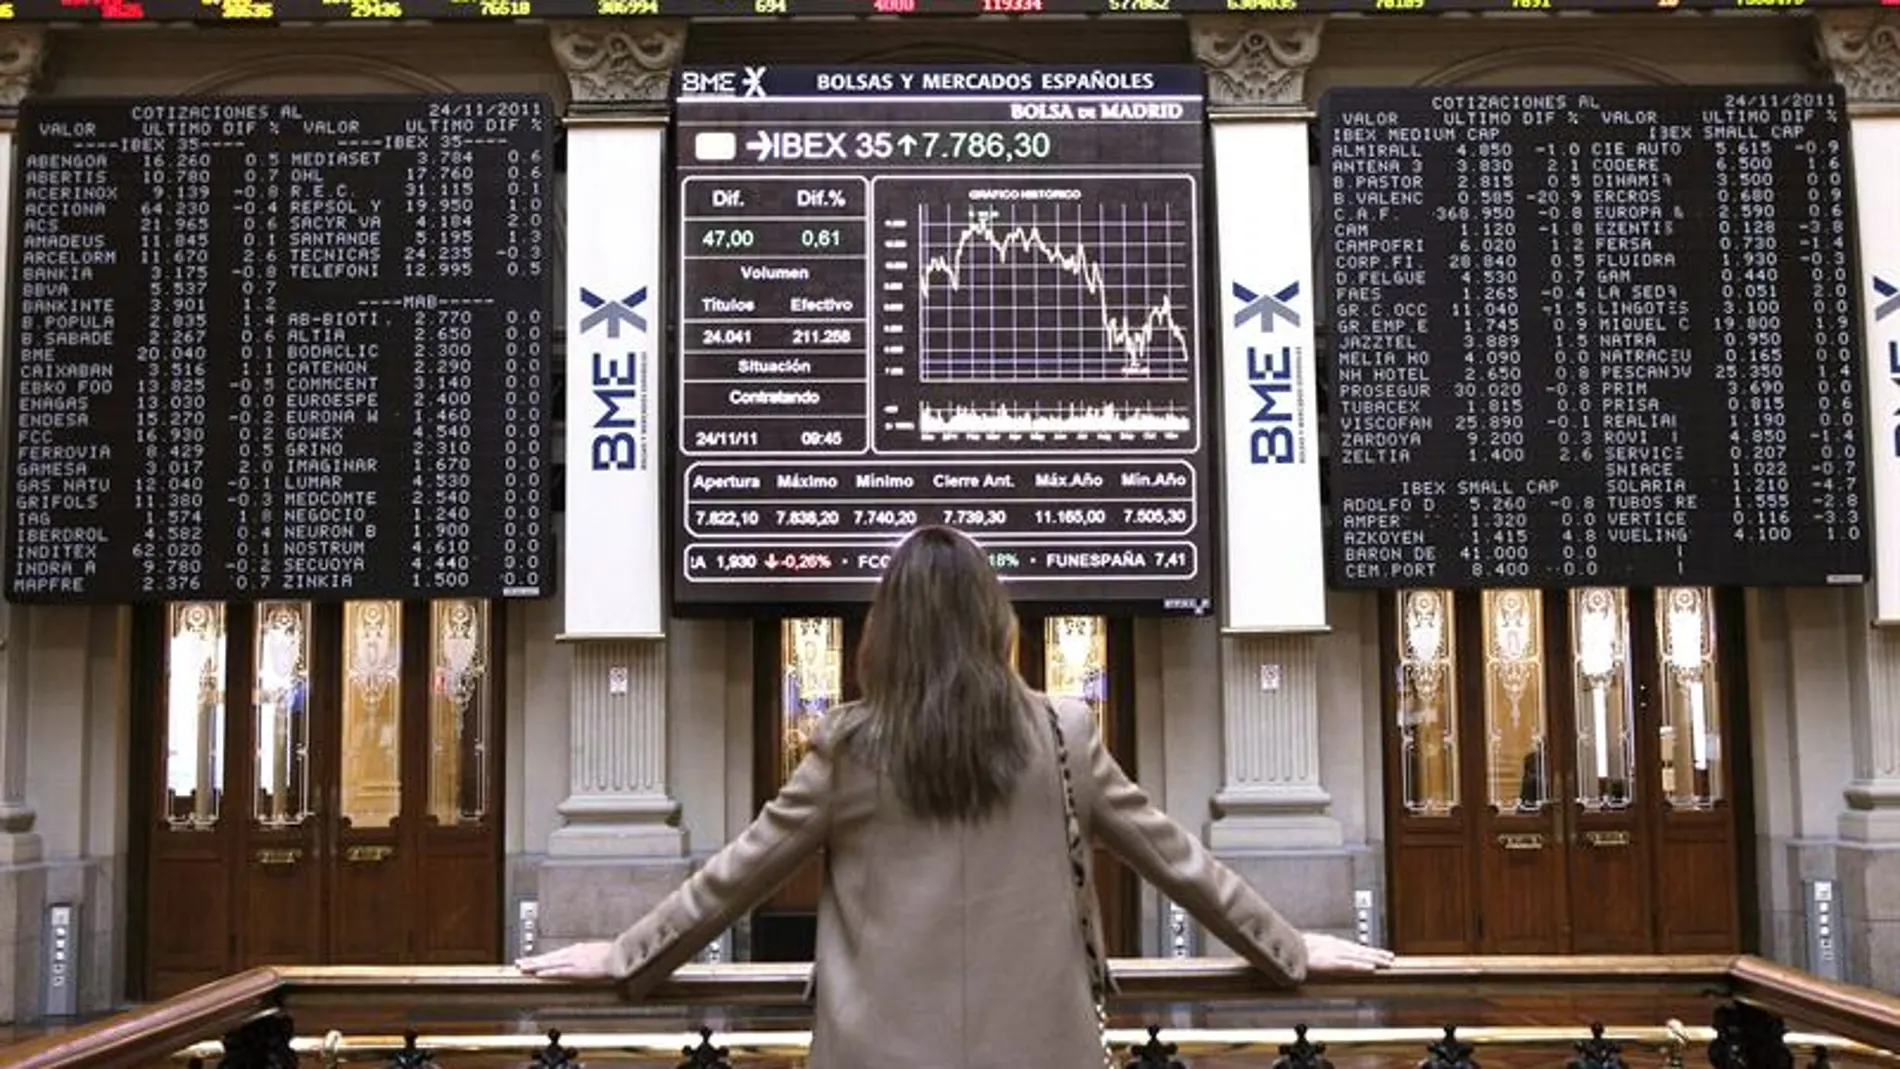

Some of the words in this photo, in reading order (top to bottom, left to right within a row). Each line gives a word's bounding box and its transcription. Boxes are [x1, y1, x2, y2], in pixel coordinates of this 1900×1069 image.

[682, 73, 736, 92] BME
[817, 74, 893, 90] BOLSAS
[901, 74, 914, 89] Y
[922, 73, 1032, 90] MERCADOS
[1042, 70, 1154, 89] ESPAÑOLES
[1432, 96, 1567, 110] COTIZACIONES
[1578, 95, 1599, 109] AL
[1725, 95, 1835, 107] 24/11/2011
[132, 106, 269, 120] COTIZACIONES
[281, 105, 302, 119] AL
[429, 103, 541, 117] 24/11/2011
[1011, 104, 1074, 119] BOLSA
[1100, 104, 1183, 119] MADRID
[1342, 113, 1399, 125] VALOR
[1443, 111, 1511, 125] ULTIMO
[1523, 111, 1555, 124] DIF
[1602, 111, 1657, 124] VALOR
[1702, 110, 1770, 123] ULTIMO
[1781, 110, 1814, 122] DIF
[39, 124, 97, 136] VALOR
[142, 124, 211, 136] ULTIMO
[223, 123, 255, 135] DIF
[304, 121, 360, 133] VALOR
[406, 119, 473, 132] ULTIMO
[486, 119, 518, 132] DIF
[531, 119, 542, 132] %
[1333, 129, 1376, 141] IBEX
[1388, 128, 1455, 140] MEDIUM
[1467, 128, 1500, 140] CAP
[773, 132, 846, 158] IBEX
[856, 132, 893, 158] 35
[922, 132, 1050, 162] 7.786,30
[1332, 145, 1422, 158] ALMIRALL
[25, 155, 108, 169] ABENGOA
[292, 153, 381, 166] MEDIASET
[1592, 159, 1659, 172] CODERE
[1332, 161, 1400, 173] ANTENA
[25, 171, 108, 184] ABERTIS
[292, 169, 324, 182] OHL
[407, 168, 473, 181] 17.760
[25, 187, 117, 200] ACERINOX
[712, 190, 744, 207] Dif.
[797, 190, 846, 207] Dif.%
[1594, 190, 1661, 202] ERCROS
[24, 203, 105, 216] ACCIONA
[24, 219, 59, 232] ACS
[1334, 223, 1369, 237] CAM
[24, 235, 105, 248] AMADEUS
[290, 232, 381, 245] SANTANDE
[702, 230, 754, 248] 47,00
[802, 230, 840, 248] 0,61
[1596, 237, 1651, 251] FERSA
[1335, 240, 1424, 252] CAMPOFRI
[23, 252, 116, 265] ARCELORM
[290, 249, 381, 262] TECNICAS
[1596, 254, 1675, 267] FLUIDRA
[23, 268, 93, 281] BANKIA
[290, 265, 379, 278] TELEFONI
[740, 266, 809, 280] Volumen
[1597, 269, 1631, 283] GAM
[1336, 288, 1381, 301] FAES
[22, 299, 114, 313] BANKINTE
[790, 298, 853, 312] Efectivo
[287, 328, 345, 342] ALTIA
[703, 329, 751, 344] 24.041
[1601, 334, 1656, 347] NATRA
[1339, 336, 1417, 350] JAZZTEL
[287, 344, 379, 359] BODACLIC
[21, 364, 113, 379] CAIXABAN
[738, 358, 811, 373] Situación
[1339, 383, 1431, 397] PROSEGUR
[1602, 382, 1647, 396] PRIM
[729, 389, 820, 404] Contratando
[19, 398, 89, 412] ENAGAS
[592, 352, 638, 470] BME
[1247, 346, 1294, 464] BME
[1341, 401, 1420, 414] TUBACEX
[1602, 398, 1659, 412] PRISA
[19, 413, 89, 427] ENDESA
[1341, 416, 1432, 430] VISCOFAN
[19, 430, 52, 444] FCC
[286, 426, 344, 440] GOWEX
[696, 431, 758, 446] 24/11/11
[801, 431, 842, 445] 09:45
[1342, 450, 1410, 464] ZELTIA
[17, 462, 87, 476] GAMESA
[287, 459, 378, 473] IMAGINAR
[1604, 463, 1673, 476] SNIACE
[284, 476, 342, 490] LUMAR
[693, 474, 761, 491] Apertura
[777, 472, 838, 488] Máximo
[933, 473, 979, 488] Cierre
[983, 473, 1015, 488] Ant.
[1401, 482, 1446, 495] IBEX
[1457, 481, 1513, 494] SMALL
[1526, 480, 1560, 494] CAP
[1606, 480, 1685, 493] SOLARIA
[16, 495, 98, 509] GRIFOLS
[18, 511, 51, 526] IAG
[284, 508, 366, 522] NEGOCIO
[854, 510, 917, 526] 7.740,20
[943, 510, 1007, 526] 7.739,30
[1344, 515, 1400, 528] AMPER
[1608, 512, 1687, 525] VERTICE
[17, 527, 109, 542] IBERDROL
[1344, 531, 1424, 544] AZKOYEN
[1608, 527, 1688, 542] VUELING
[17, 544, 97, 559] INDITEX
[284, 541, 364, 556] NOSTRUM
[284, 557, 365, 572] SECUOYA
[1046, 552, 1145, 567] FUNESPAÑA
[1155, 553, 1186, 568] 7,41
[14, 577, 84, 592] MAPFRE
[283, 574, 352, 588] ZINKIA
